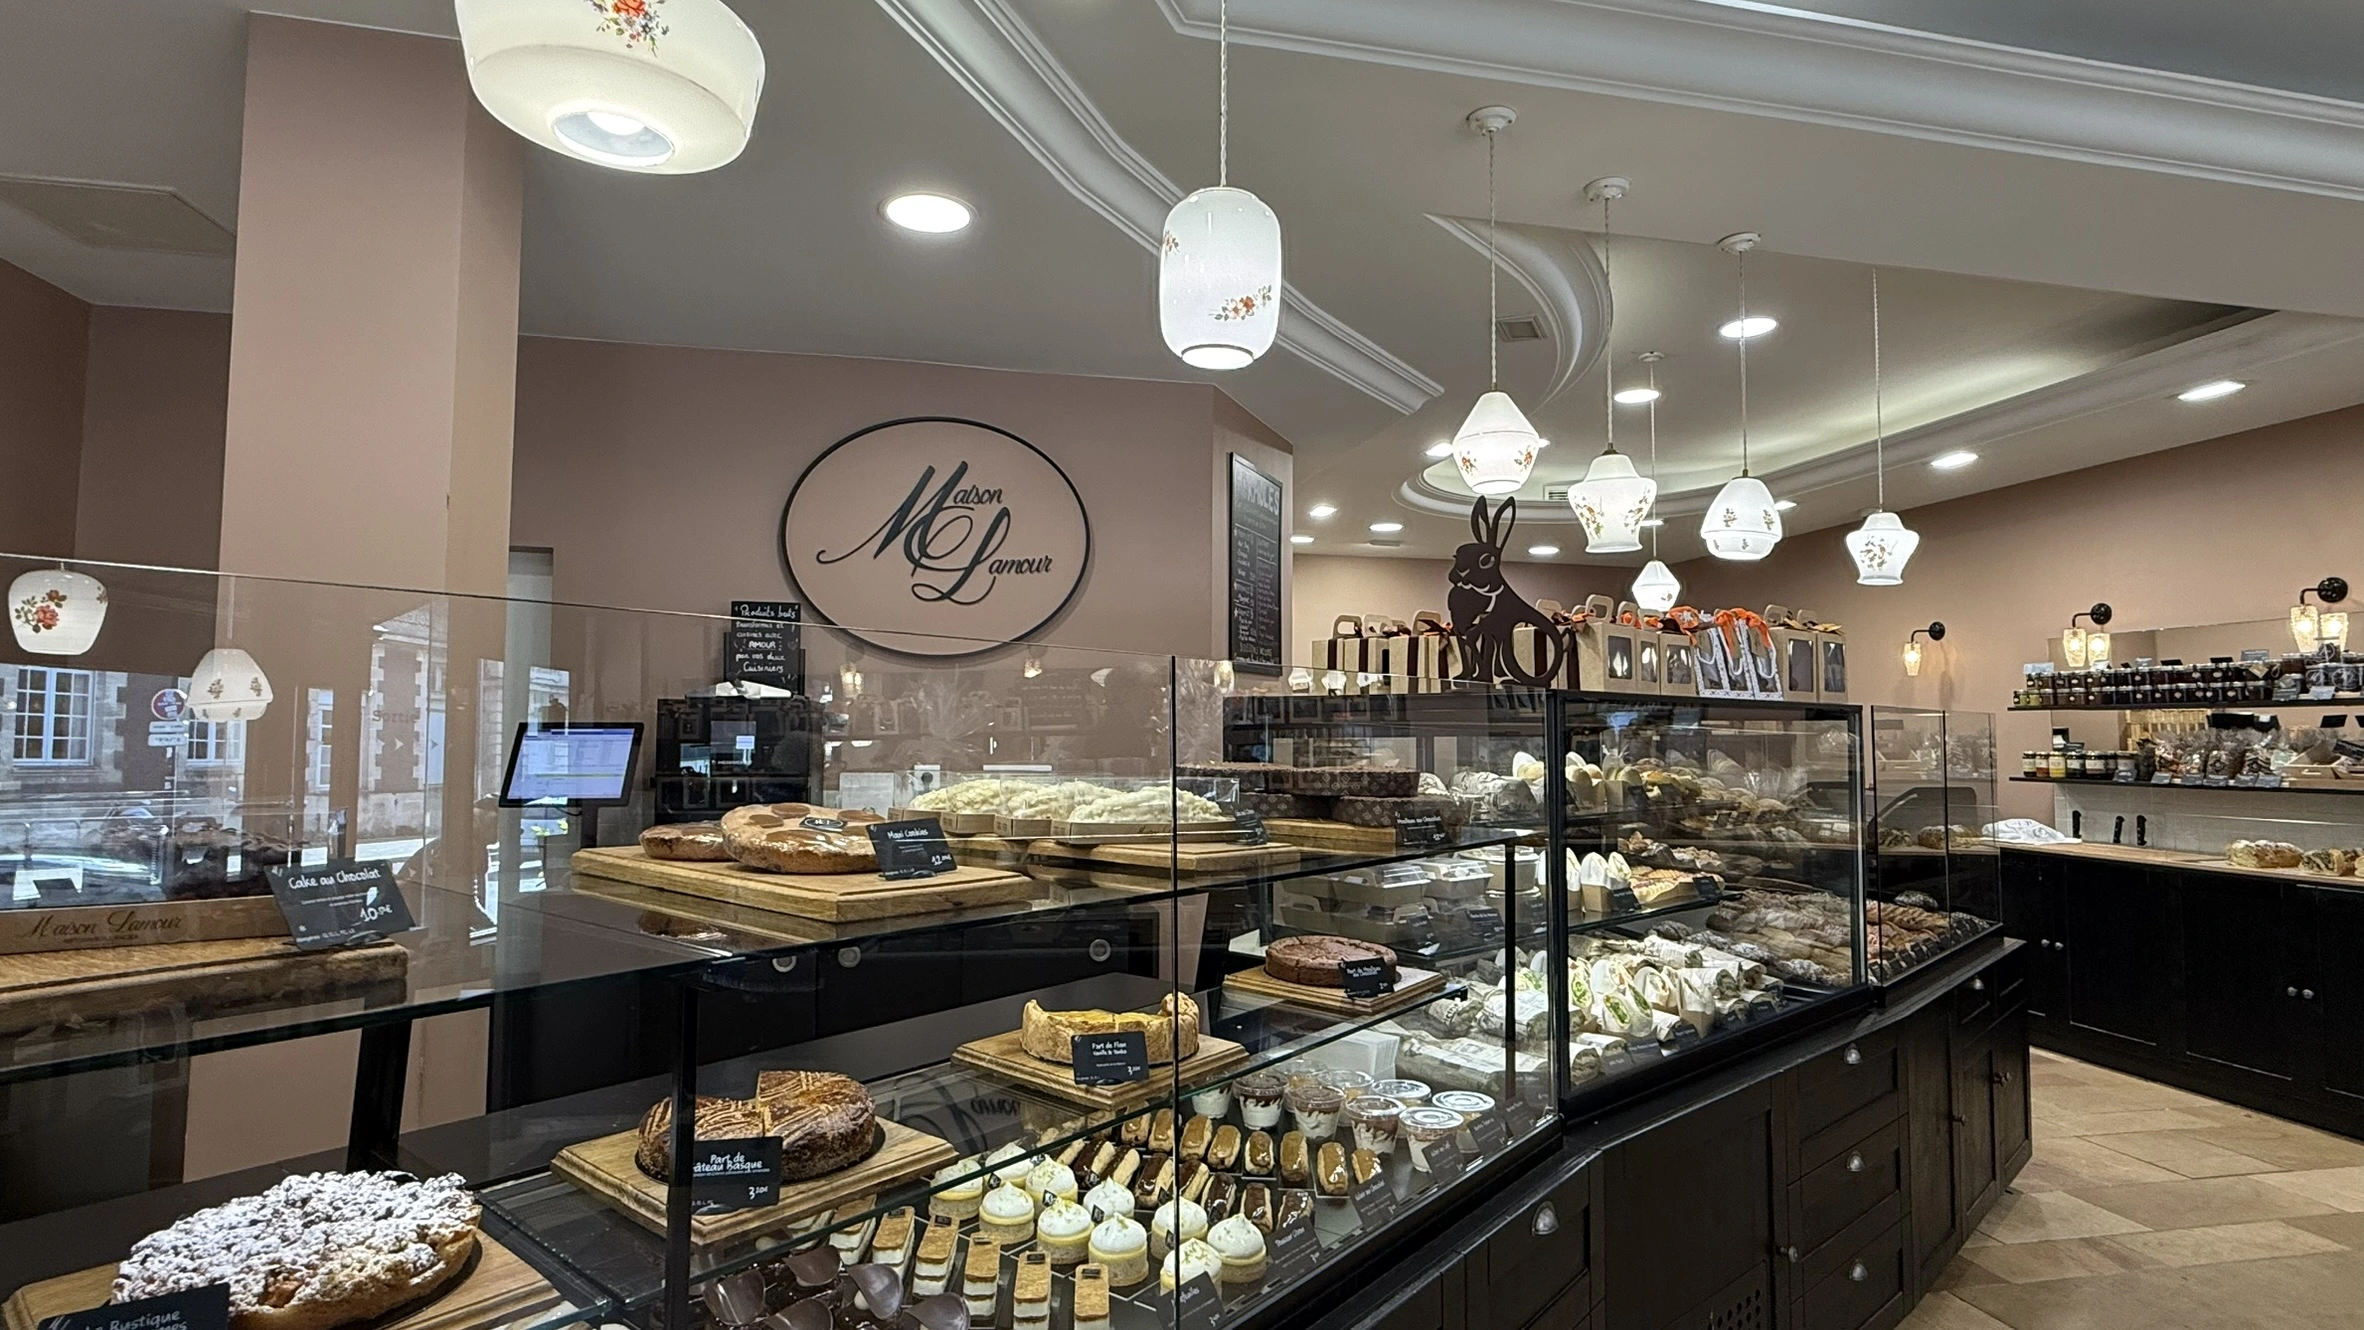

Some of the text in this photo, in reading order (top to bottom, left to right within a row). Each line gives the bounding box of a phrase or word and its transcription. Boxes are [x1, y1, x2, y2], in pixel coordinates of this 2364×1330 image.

[816, 461, 1003, 577] Maison
[904, 506, 1053, 605] Lamour
[740, 604, 775, 617] Produits
[748, 640, 776, 649] AMOUR
[735, 654, 749, 662] par
[767, 652, 786, 661] deux
[743, 661, 784, 674] Cuisiniers
[887, 827, 929, 840] Maxi Cookies
[288, 868, 382, 890] Cake au Chocolat
[18, 909, 184, 938] Maison Lamour
[1091, 1042, 1105, 1050] Part
[1105, 1041, 1113, 1049] de
[710, 1151, 745, 1164] Part de
[693, 1160, 763, 1173] âteau Basque
[110, 1310, 181, 1330] Rustique
